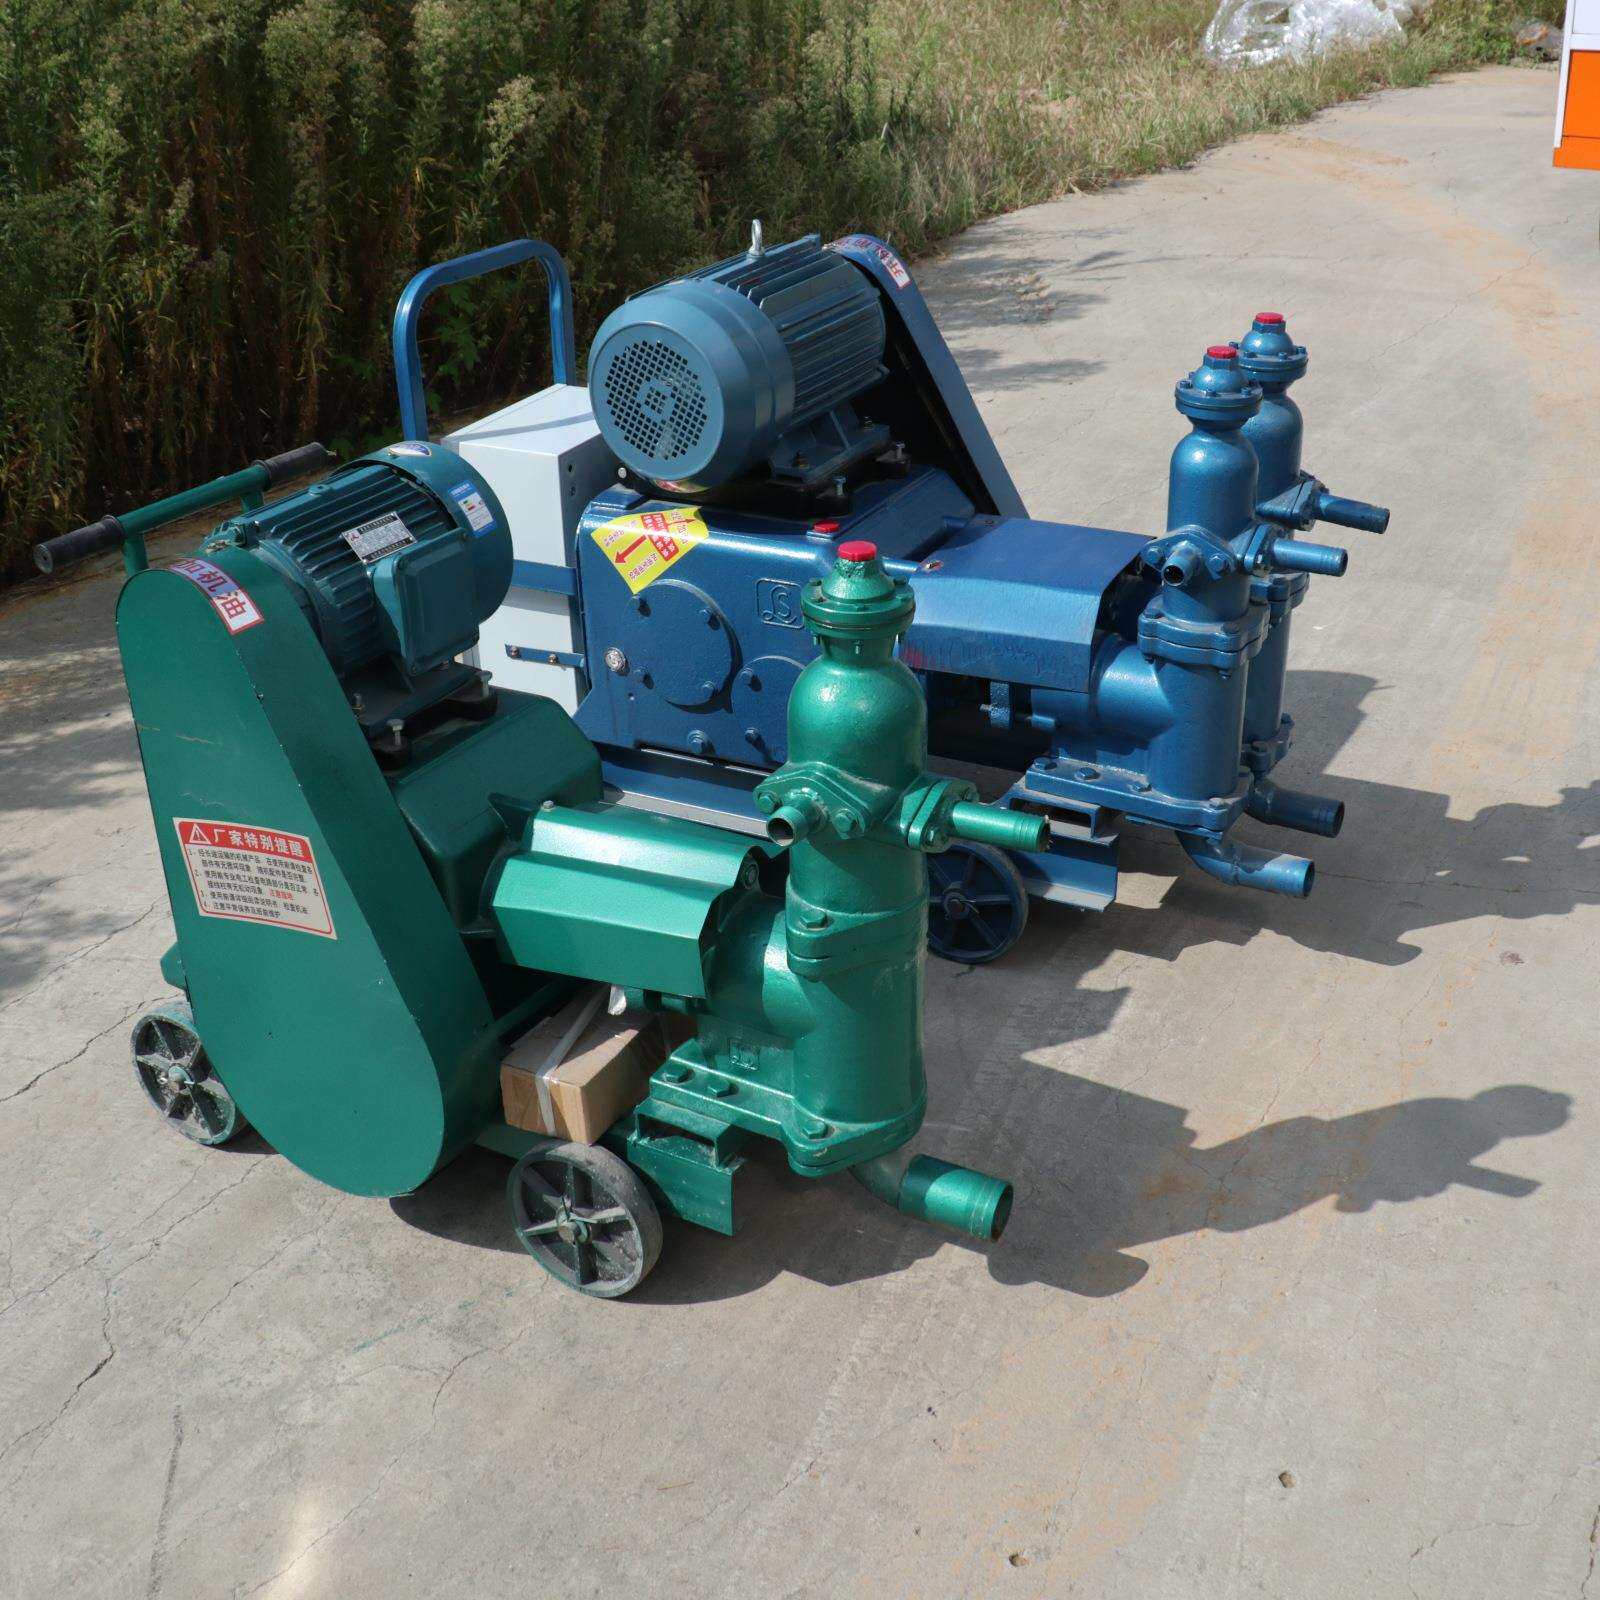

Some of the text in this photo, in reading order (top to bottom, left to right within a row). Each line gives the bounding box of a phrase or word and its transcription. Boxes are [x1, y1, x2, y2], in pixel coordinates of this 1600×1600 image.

[213, 828, 304, 858] 厂家特别提醒
